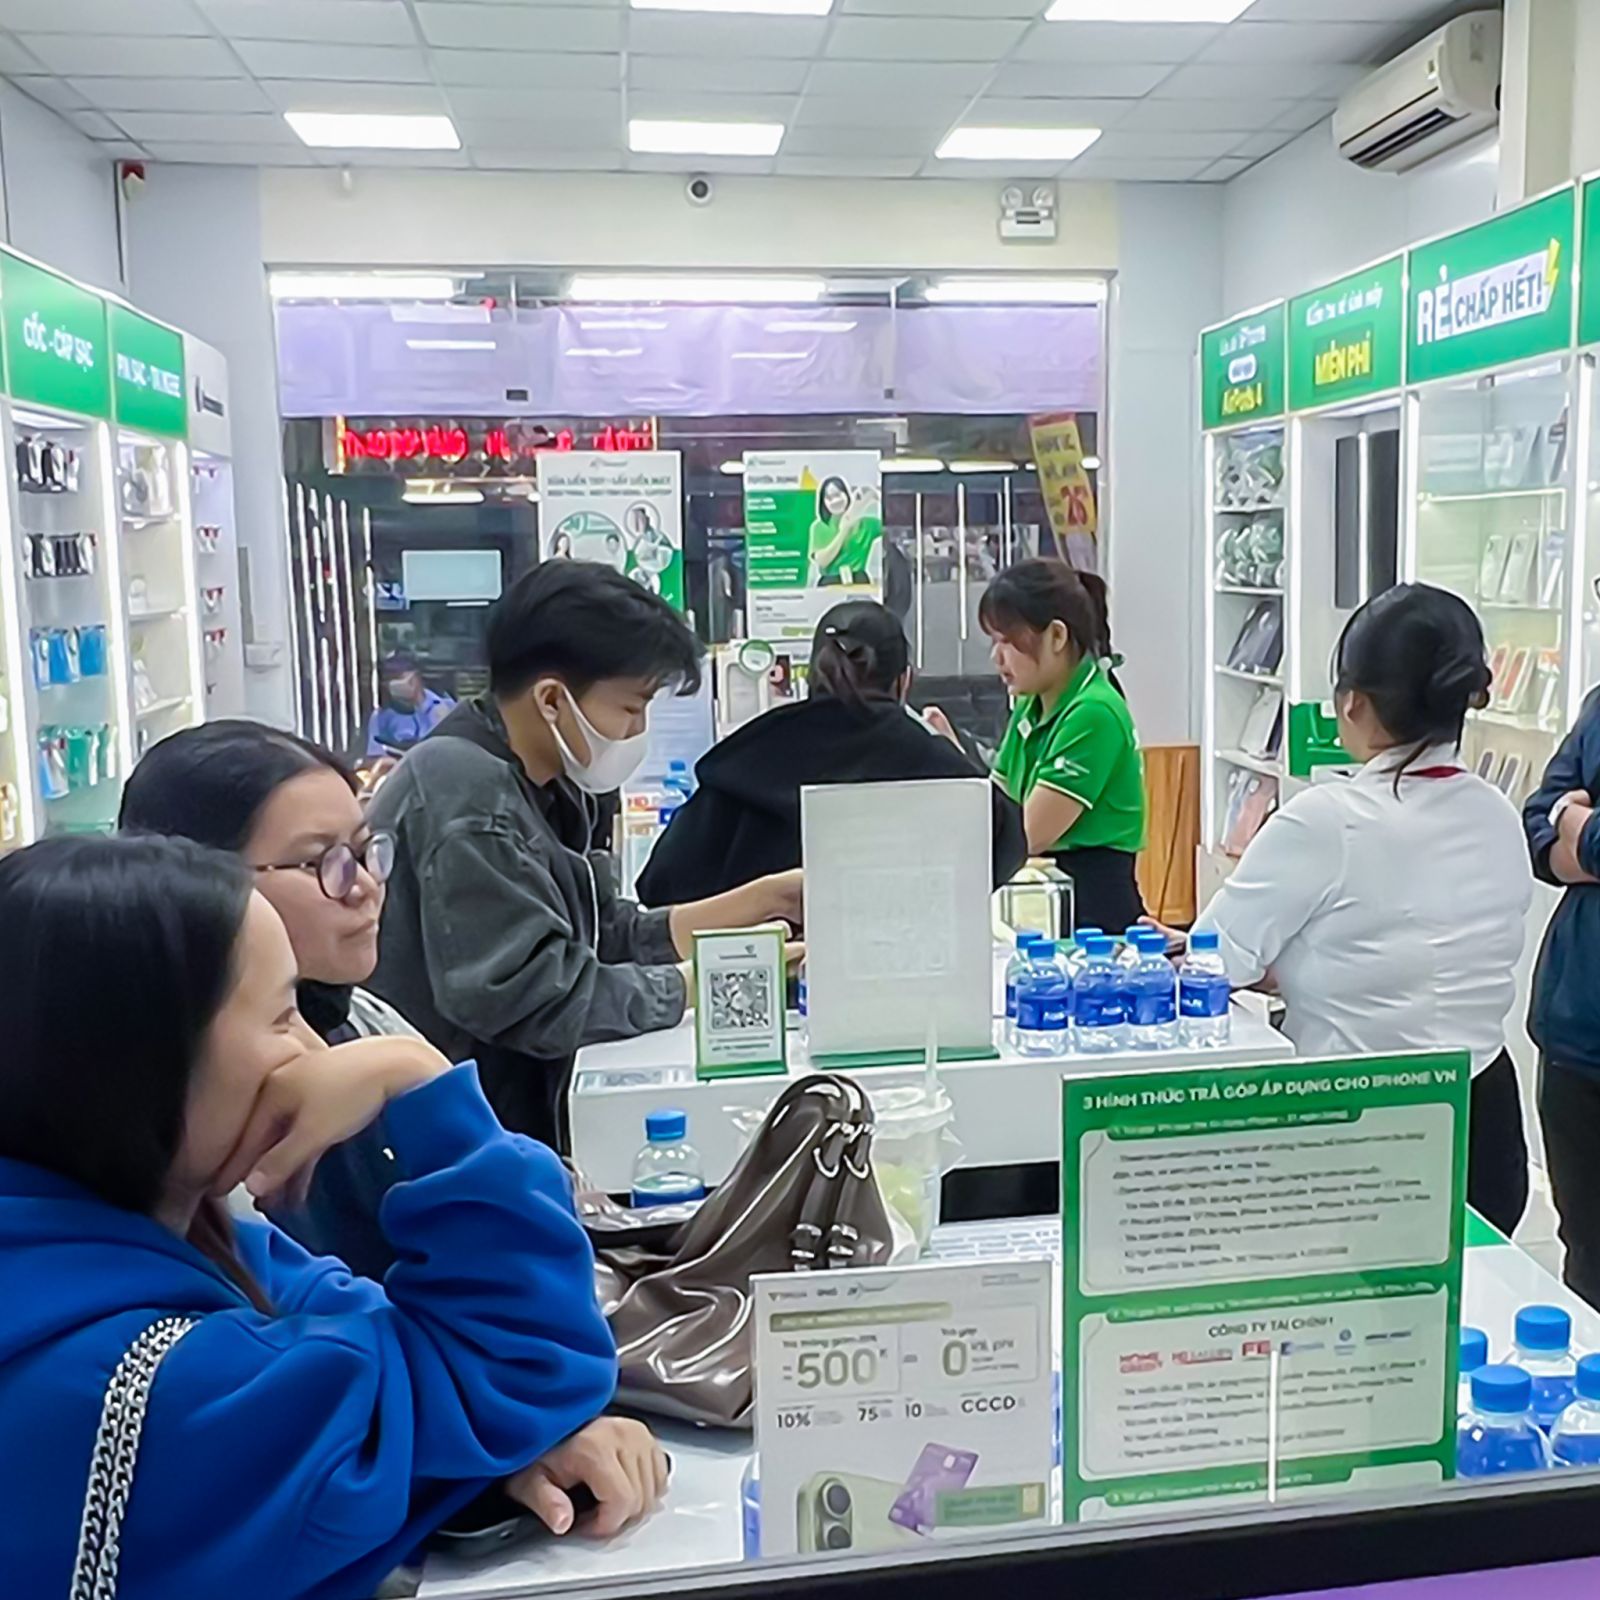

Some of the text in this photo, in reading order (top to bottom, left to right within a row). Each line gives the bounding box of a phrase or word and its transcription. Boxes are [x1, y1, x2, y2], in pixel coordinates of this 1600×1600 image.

[1417, 263, 1542, 345] RẺ CHẤP HẾT!
[1347, 330, 1371, 378] PHÍ
[1082, 1096, 1094, 1110] 3
[1188, 1082, 1221, 1101] TRẢ
[1223, 1083, 1258, 1099] GÓP
[1260, 1079, 1282, 1096] ÁP
[1285, 1078, 1331, 1096] DỤNG
[1334, 1076, 1370, 1092] CHO
[1372, 1071, 1431, 1088] IPHONE
[1433, 1069, 1457, 1083] VN
[1208, 1324, 1248, 1338] CÔNG
[1252, 1322, 1266, 1333] TY
[797, 1348, 877, 1390] 500
[943, 1340, 967, 1376] 0
[858, 1406, 879, 1422] 75
[905, 1402, 922, 1419] 10
[961, 1394, 1017, 1414] CCCD
[777, 1411, 811, 1428] 10%
